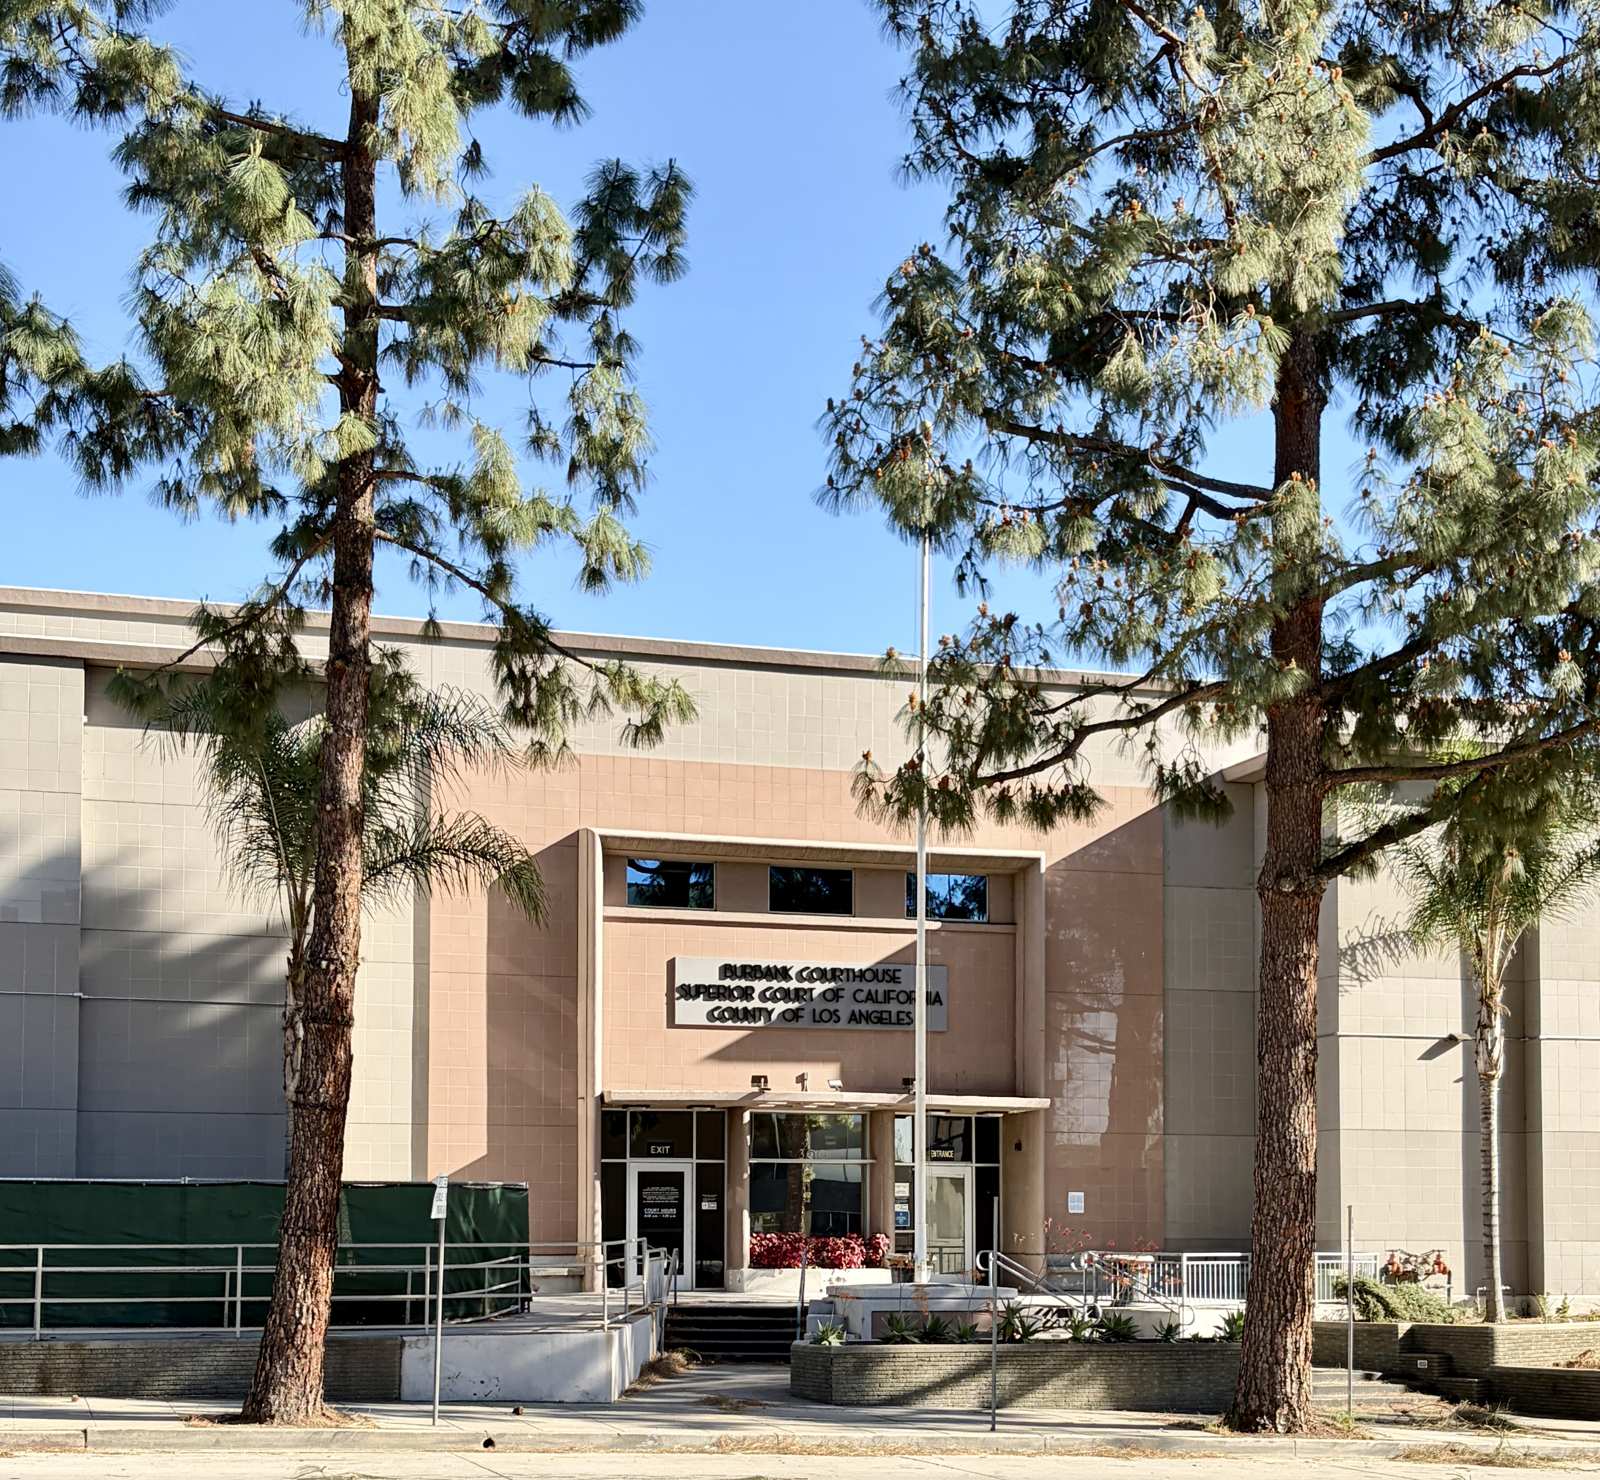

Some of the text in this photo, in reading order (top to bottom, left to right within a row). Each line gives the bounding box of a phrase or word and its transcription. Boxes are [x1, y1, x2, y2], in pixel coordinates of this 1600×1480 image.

[720, 964, 902, 984] BURBANK COURTHOUSE
[677, 984, 943, 1006] SUPERIOR COURT OF CALIFORIA
[708, 1006, 913, 1025] COUNTY OF LOS ANGELES
[650, 1145, 671, 1154] EXIT
[930, 1149, 954, 1158] ENTRANCE
